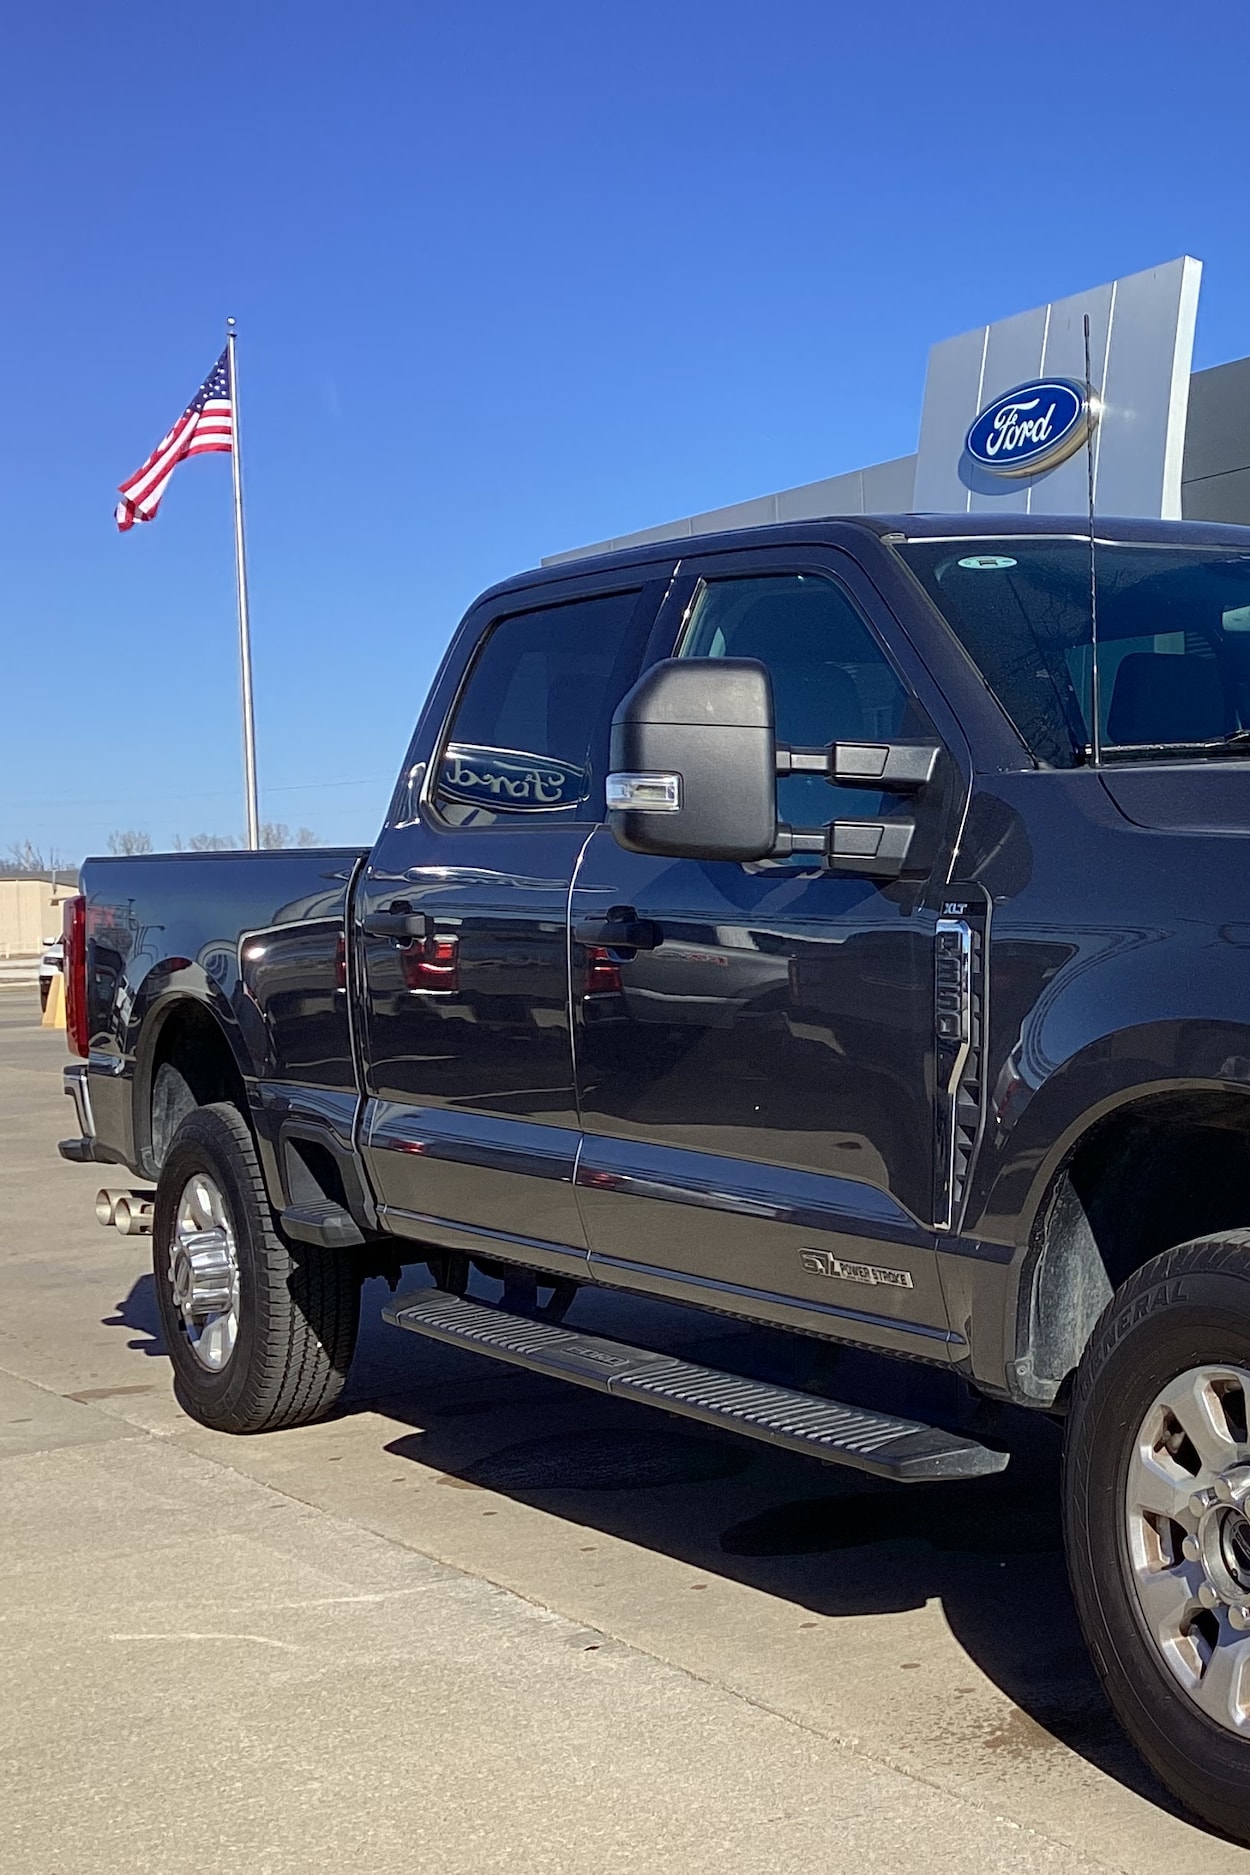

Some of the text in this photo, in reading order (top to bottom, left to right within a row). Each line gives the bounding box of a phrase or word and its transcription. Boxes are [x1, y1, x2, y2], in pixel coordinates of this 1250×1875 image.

[985, 398, 1057, 456] Ford
[943, 902, 968, 915] XLT
[872, 1267, 909, 1286] STROKE
